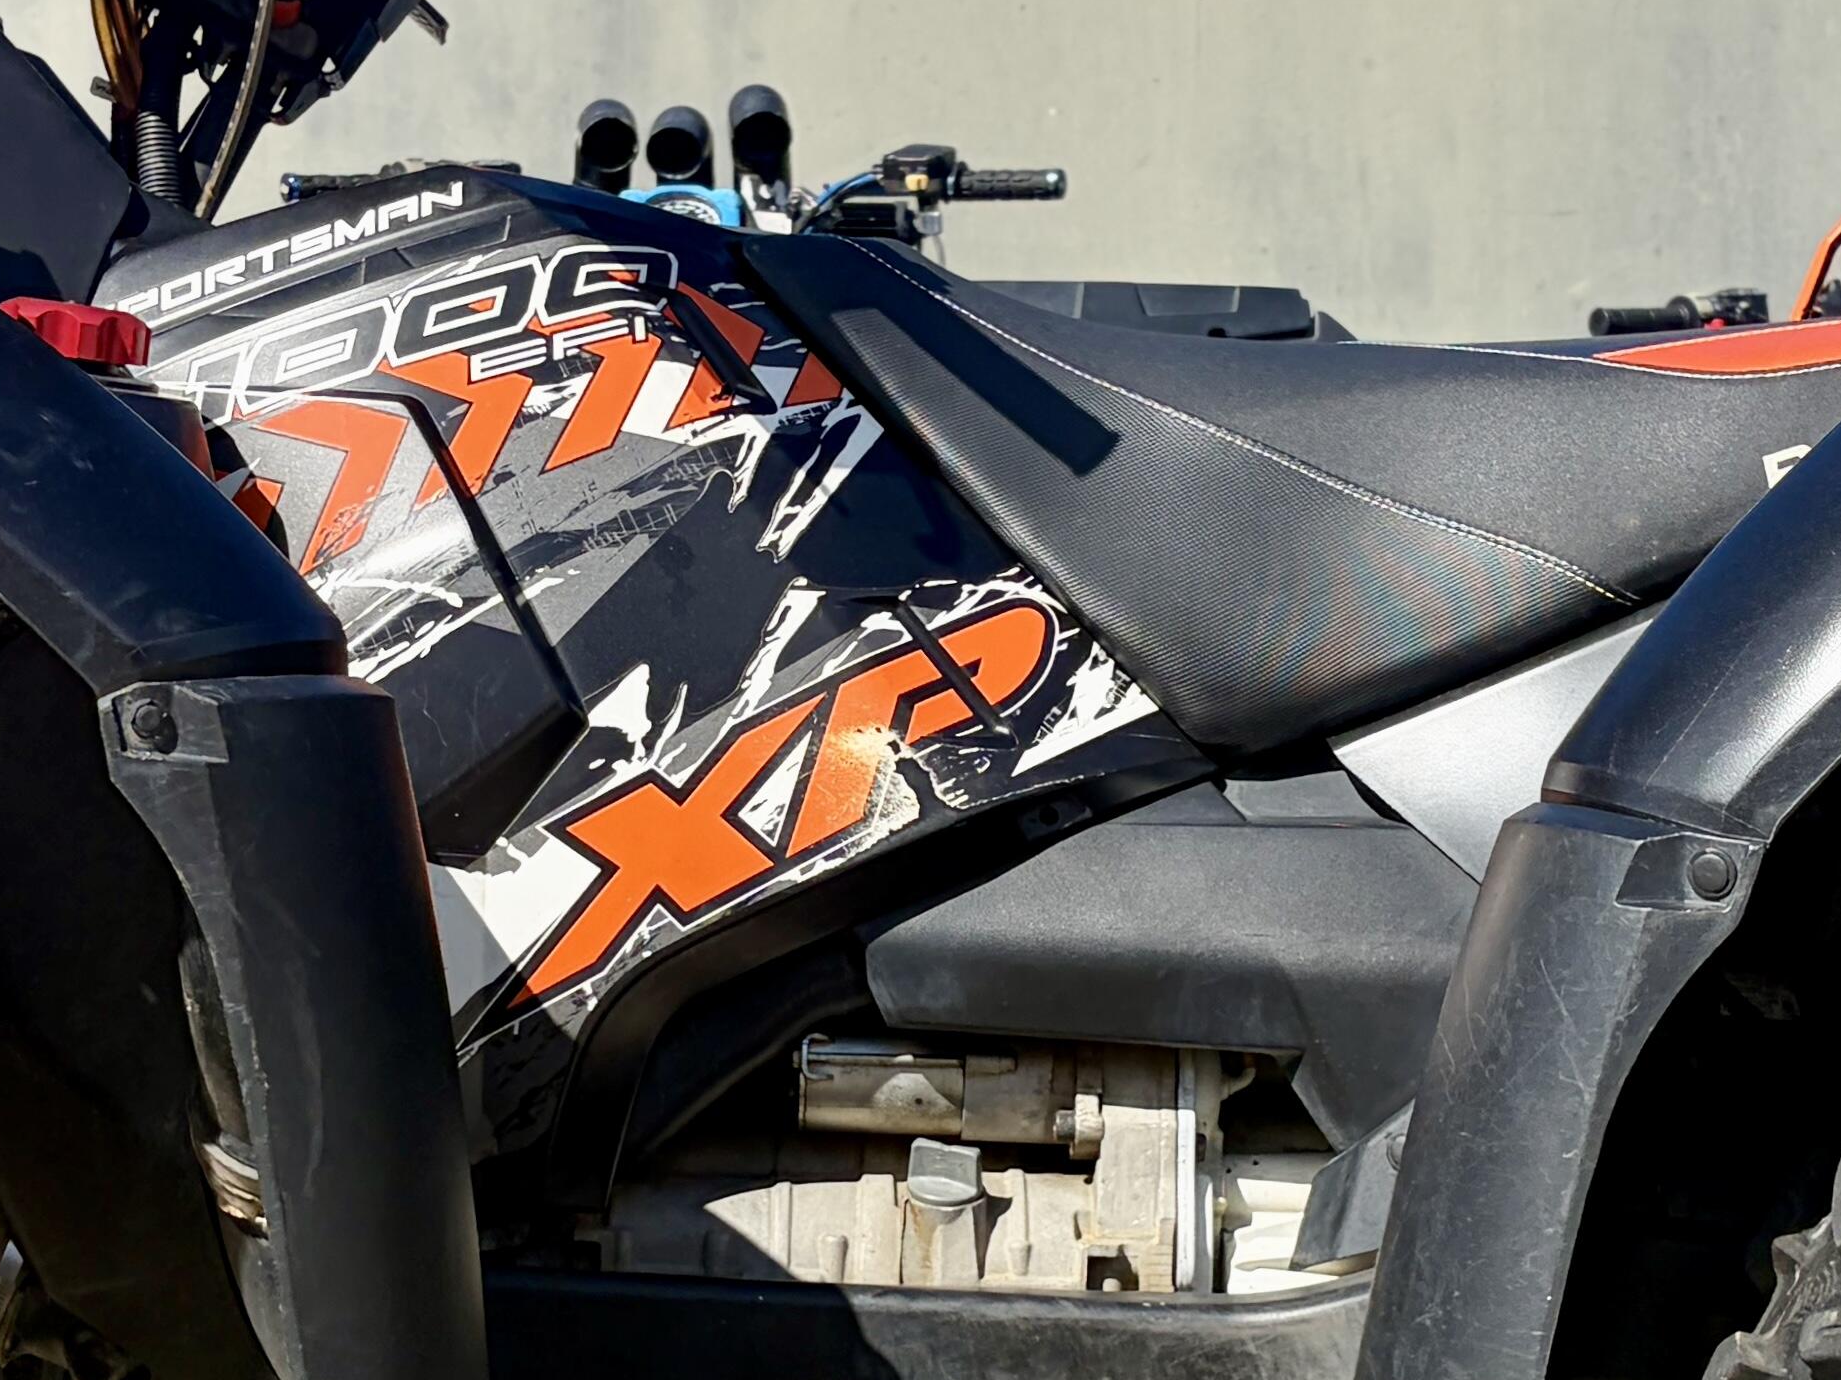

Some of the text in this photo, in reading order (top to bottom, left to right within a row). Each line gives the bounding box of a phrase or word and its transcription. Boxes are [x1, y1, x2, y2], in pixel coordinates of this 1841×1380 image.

[110, 180, 464, 314] PORTSMAN
[470, 315, 648, 382] EFI
[504, 603, 1048, 1010] XP
